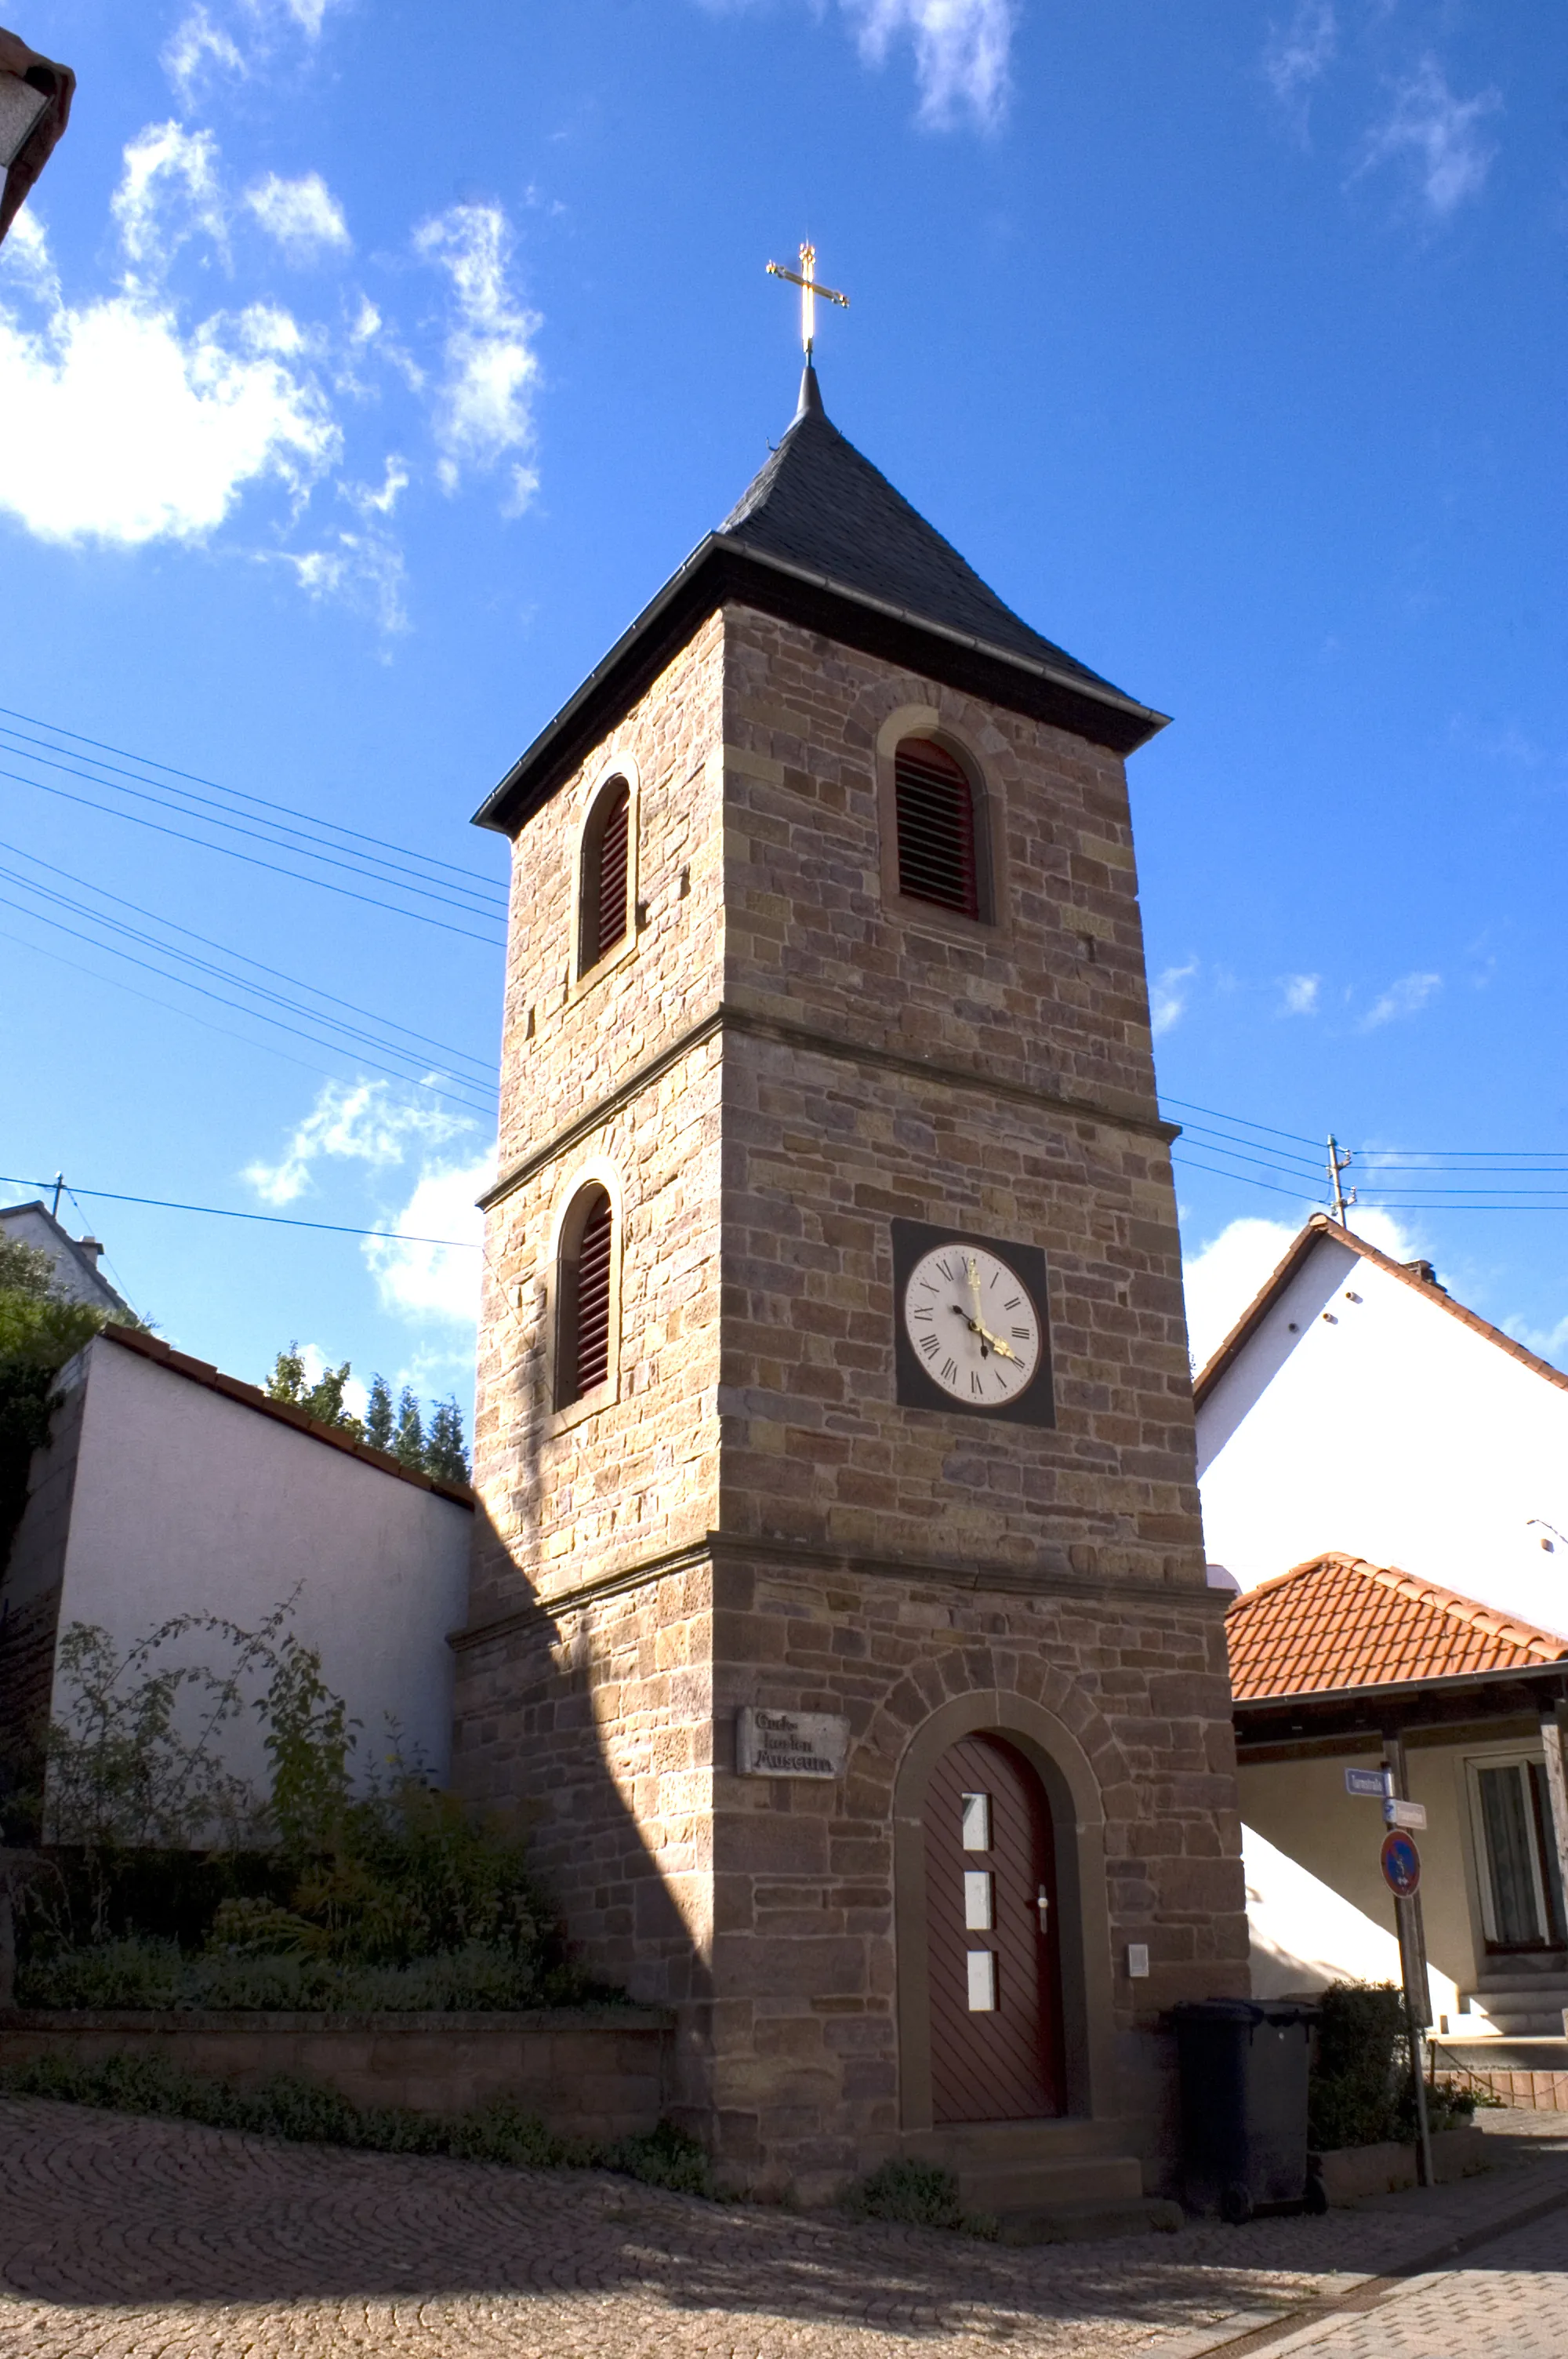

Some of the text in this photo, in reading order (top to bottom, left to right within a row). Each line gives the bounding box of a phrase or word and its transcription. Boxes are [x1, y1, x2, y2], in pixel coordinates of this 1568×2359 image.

[1004, 1297, 1022, 1311] II
[1011, 1326, 1030, 1340] III
[753, 1750, 833, 1772] Museum
